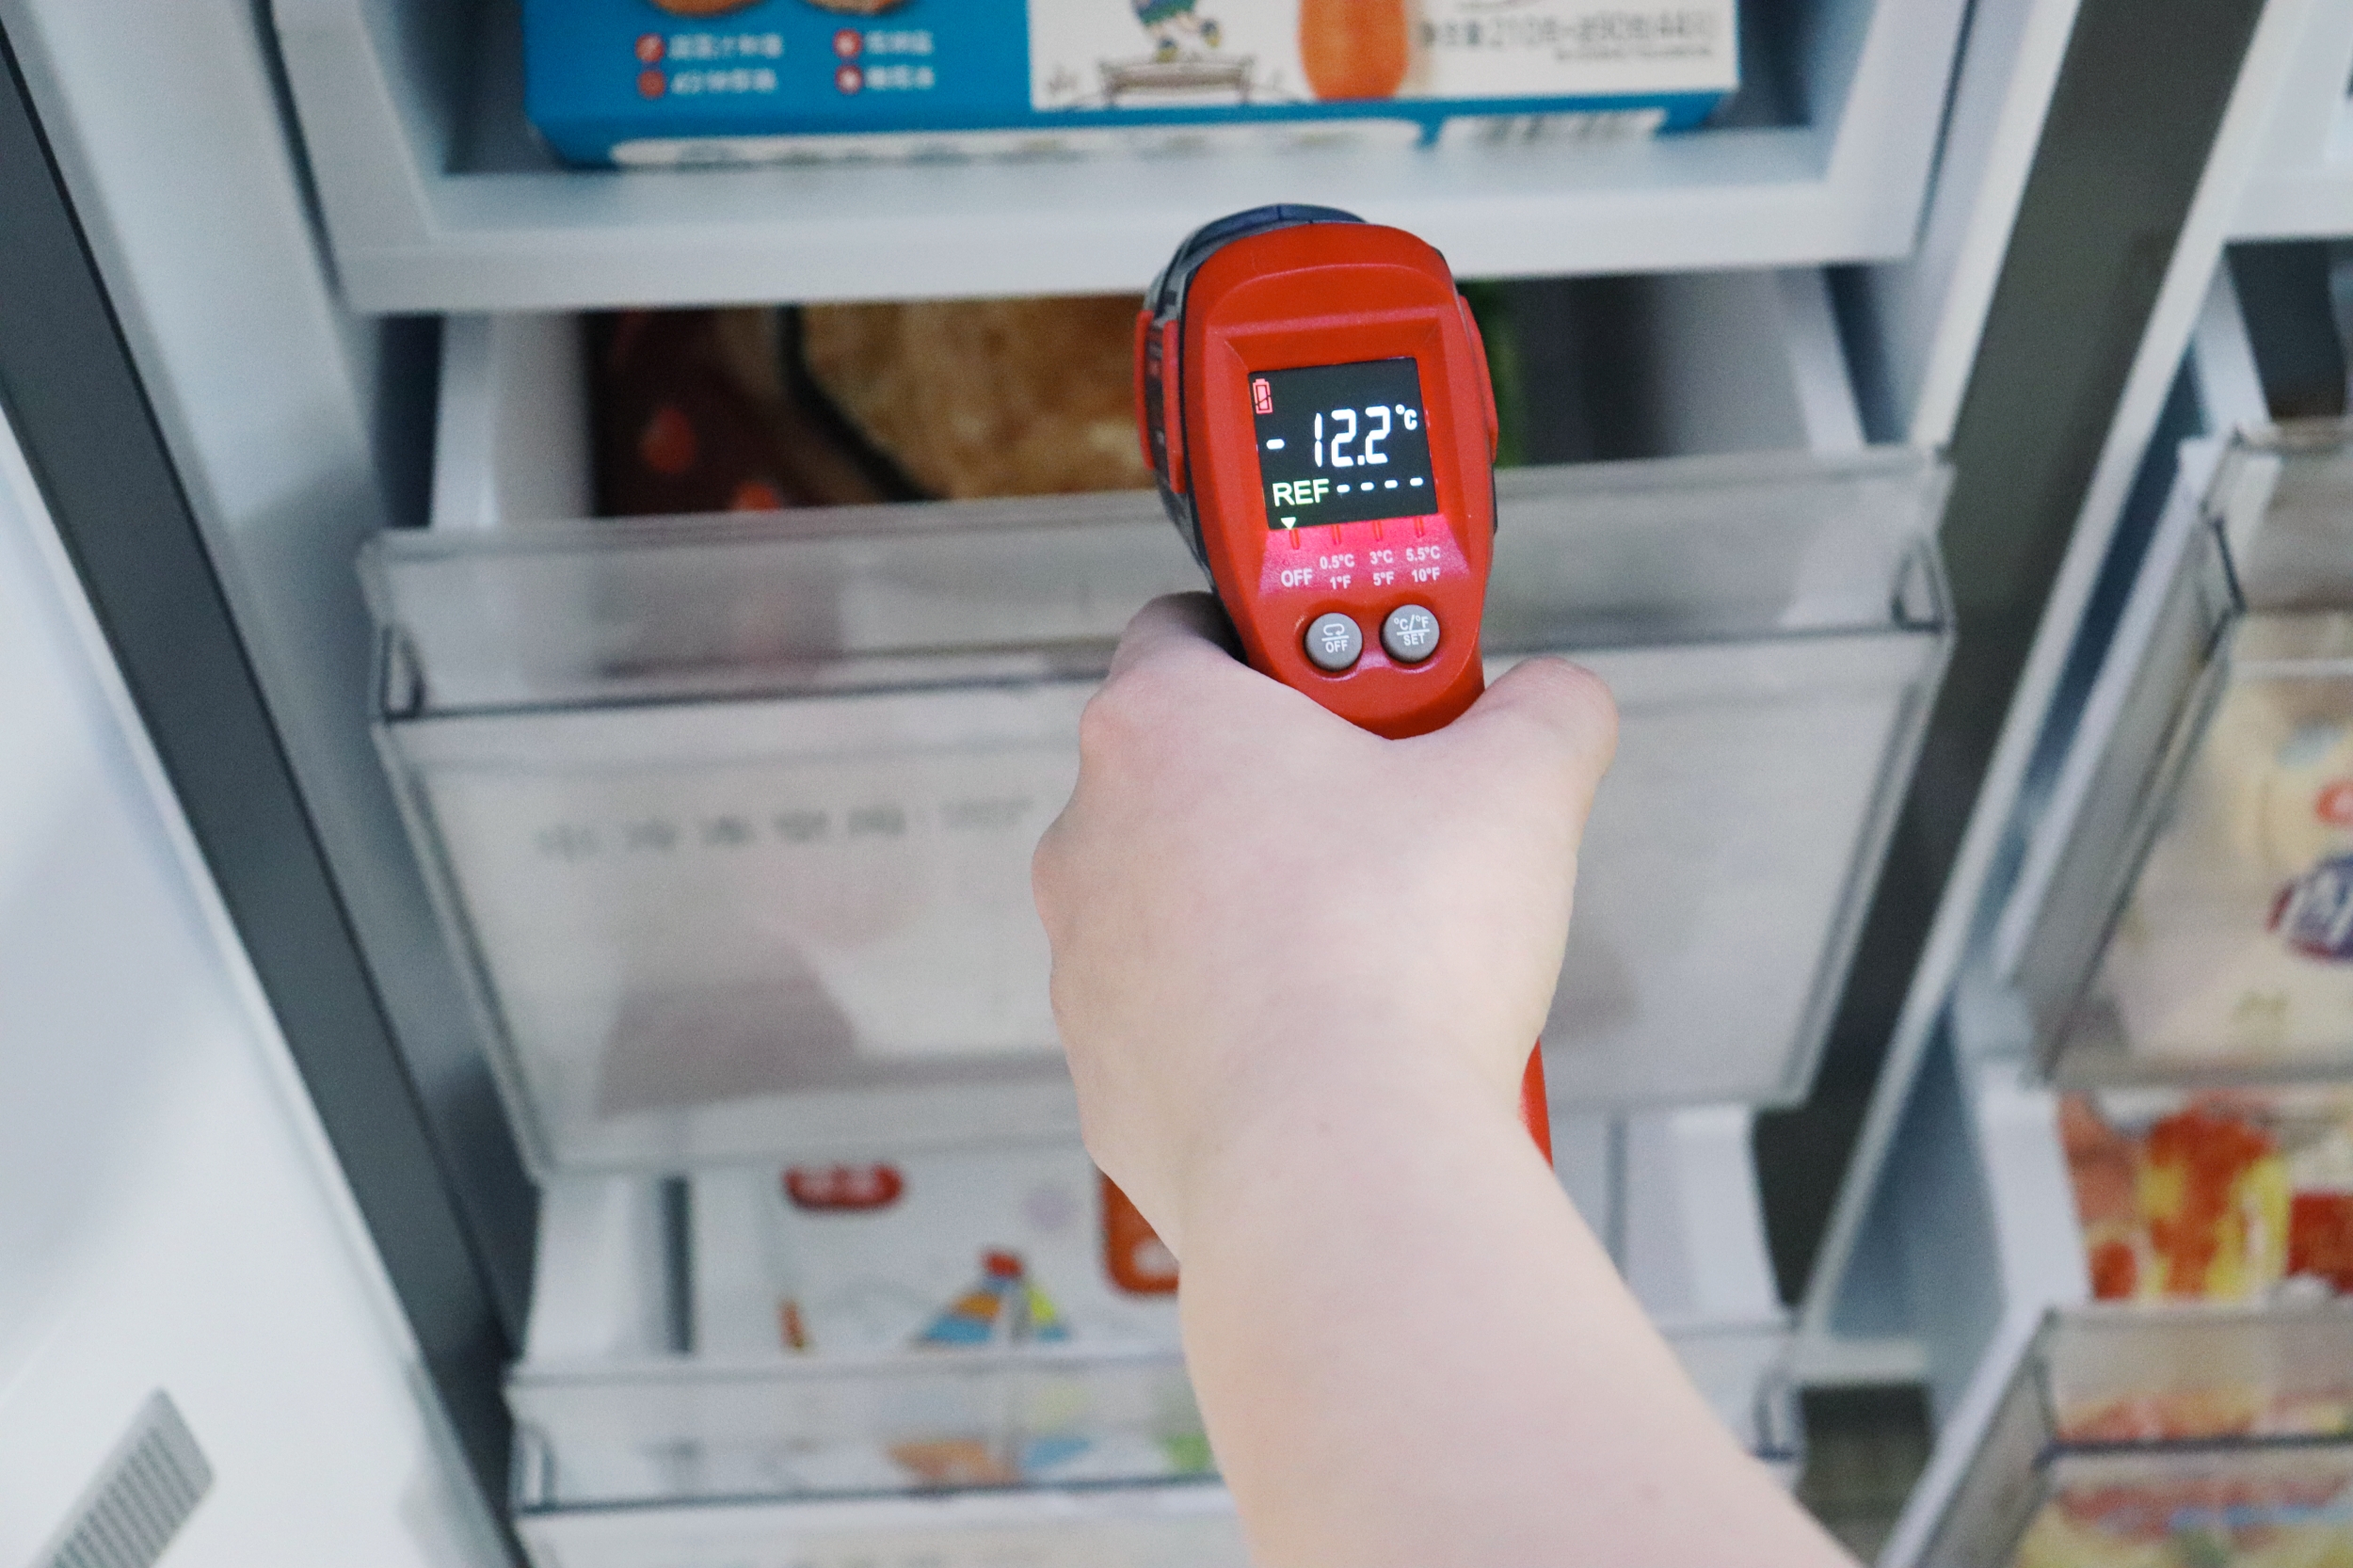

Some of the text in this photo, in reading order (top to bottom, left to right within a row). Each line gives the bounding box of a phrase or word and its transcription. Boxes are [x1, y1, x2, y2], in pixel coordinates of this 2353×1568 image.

[1273, 478, 1329, 506] REF
[1320, 546, 1441, 570] 0.5°C 3°C 5.5°C
[1281, 567, 1441, 590] OFF 1°F 5°F 10°F
[1325, 639, 1348, 653] OFF
[1403, 632, 1425, 647] SET
